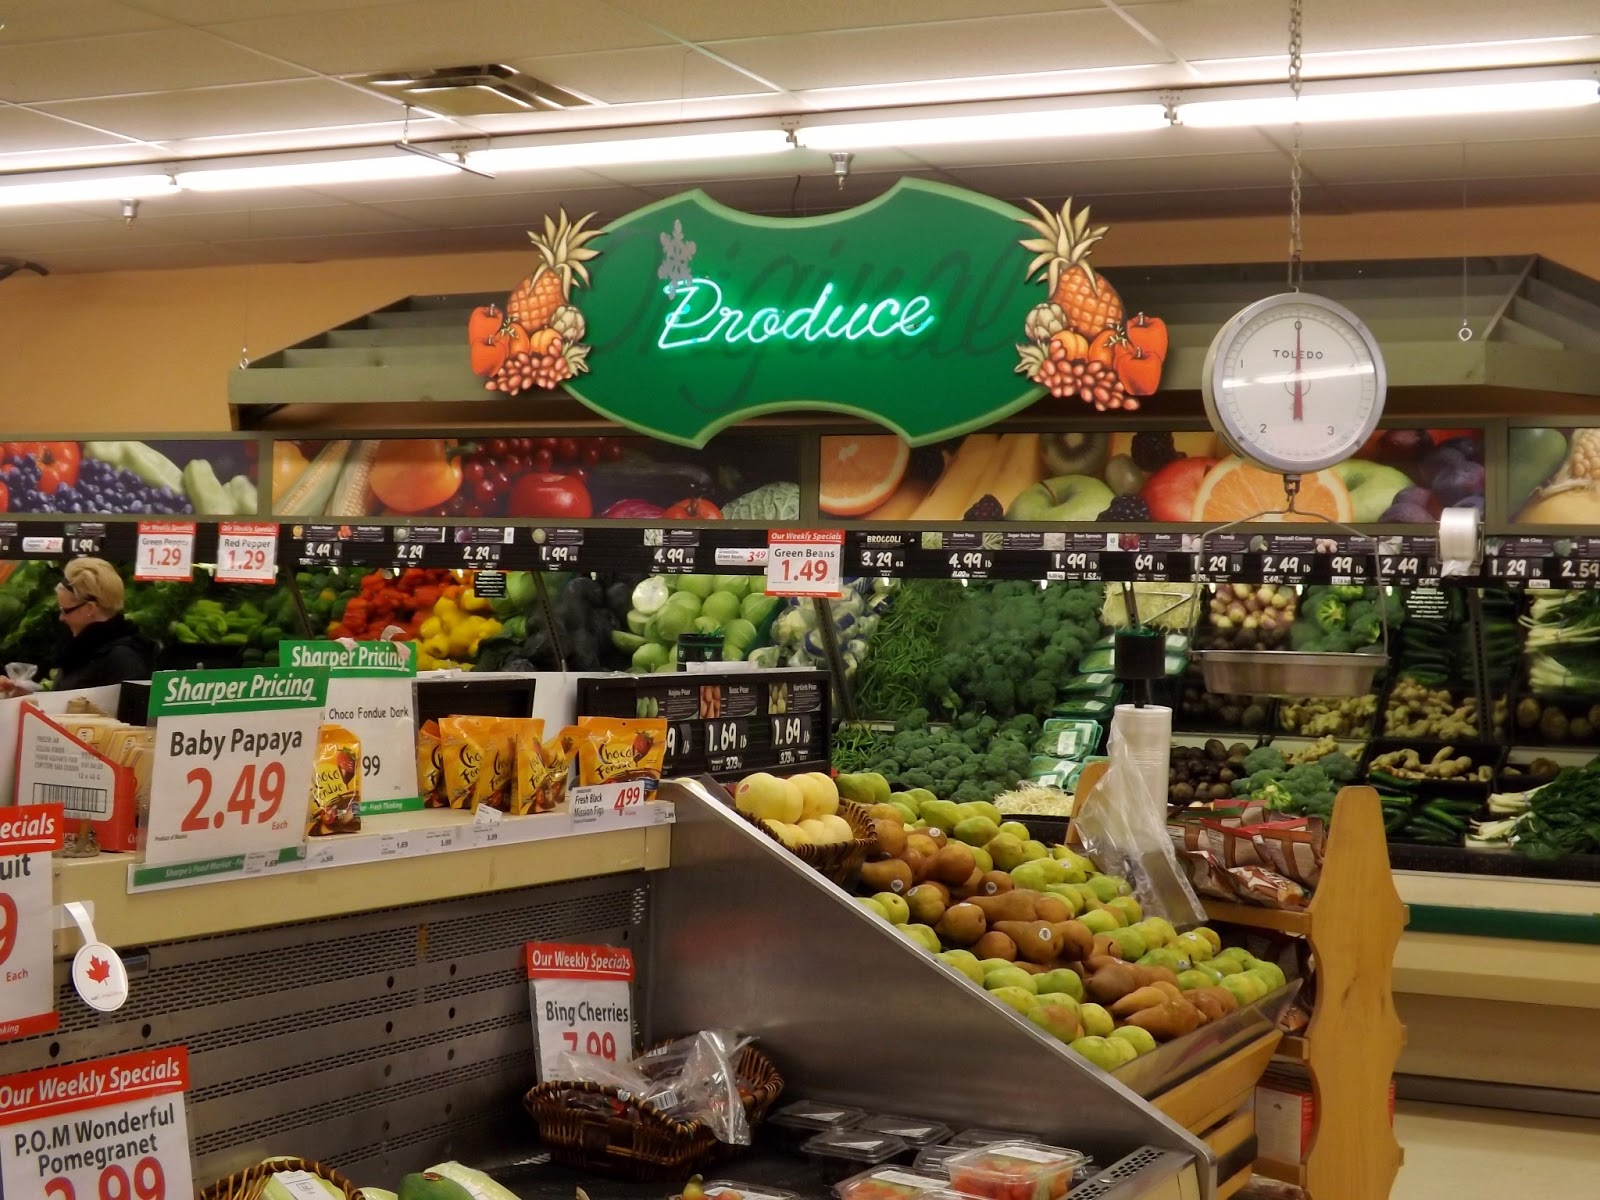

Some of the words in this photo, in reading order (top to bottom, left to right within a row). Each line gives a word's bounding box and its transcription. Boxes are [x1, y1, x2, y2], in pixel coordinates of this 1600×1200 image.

[657, 277, 936, 350] Produce
[1272, 349, 1324, 360] TOLEDO
[1260, 424, 1268, 434] 2
[1327, 426, 1335, 436] 3
[142, 538, 162, 546] Green
[224, 538, 240, 547] Red
[242, 539, 271, 550] Pepper
[786, 532, 812, 540] Weekly
[812, 532, 842, 540] Specials
[866, 534, 902, 543] BROCCOLI
[148, 548, 182, 566] 1.29
[305, 542, 330, 557] 3.49
[397, 544, 424, 558] 2.29
[462, 546, 490, 560] 2.29
[541, 546, 568, 562] 1.99
[654, 548, 684, 564] 4.99
[774, 548, 803, 558] Green
[806, 549, 835, 558] Beans
[228, 550, 266, 570] 1.29
[862, 551, 892, 568] 3.29
[948, 552, 982, 568] 4.99
[1055, 554, 1087, 569] 1.99
[1134, 554, 1154, 570] 69
[1194, 556, 1228, 572] 1.29
[1262, 556, 1300, 573] 2.49
[1332, 556, 1353, 574] 99
[1382, 558, 1418, 574] 2.49
[1492, 559, 1526, 576] 1.29
[782, 560, 828, 582] 1.49
[1562, 560, 1600, 578] 2.59
[291, 645, 356, 672] Sharper
[358, 646, 406, 671] Pricing
[164, 674, 245, 706] Sharper
[250, 672, 315, 700] Pricing
[328, 708, 354, 720] Choco
[358, 706, 386, 718] Fondue
[390, 706, 409, 718] Dark
[708, 722, 737, 752] 1.69
[774, 717, 800, 746] 1.69
[170, 729, 226, 761] Baby
[230, 727, 303, 758] Papaya
[598, 740, 632, 764] Choco
[180, 760, 286, 832] 2.49
[574, 796, 589, 805] Fresh
[590, 792, 602, 802] Black
[574, 807, 594, 818] Mission
[272, 820, 288, 831] Each
[532, 951, 551, 968] Our
[554, 952, 590, 972] Weekly
[590, 953, 631, 972] Specials
[6, 968, 28, 982] Each
[546, 1000, 576, 1026] Bing
[578, 1001, 628, 1022] Cherries
[0, 1086, 34, 1109] Our
[38, 1070, 106, 1101] Weekly
[109, 1056, 180, 1092] Specials
[14, 1124, 71, 1157] P.O.M
[74, 1102, 174, 1144] Wonderful
[38, 1132, 158, 1177] Pomegranet
